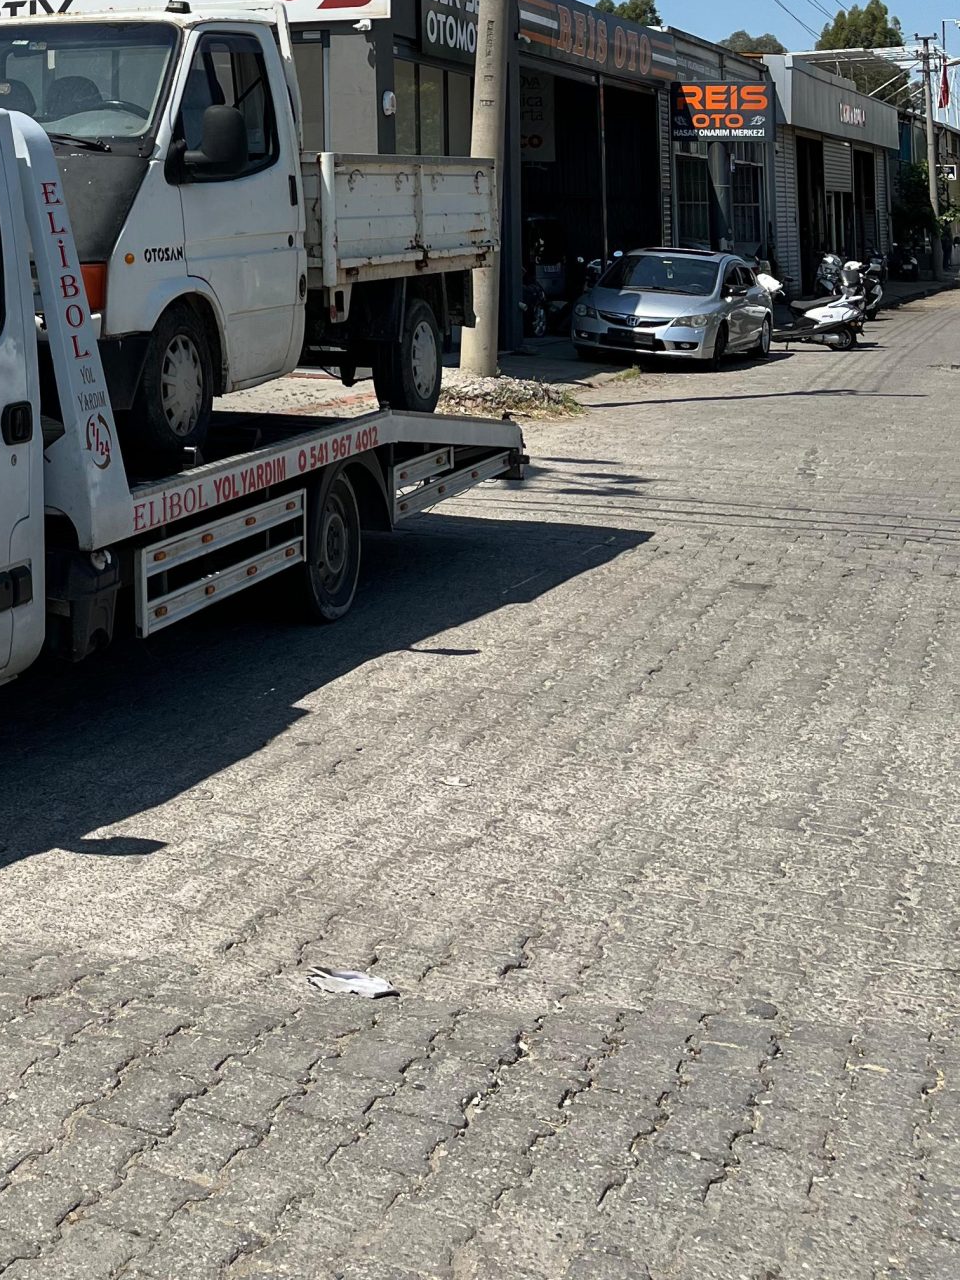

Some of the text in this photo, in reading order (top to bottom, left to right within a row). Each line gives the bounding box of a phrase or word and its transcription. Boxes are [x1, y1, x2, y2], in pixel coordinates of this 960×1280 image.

[614, 25, 652, 75] OTO
[692, 113, 744, 128] OTO
[698, 129, 730, 137] ONARIM
[731, 127, 765, 137] MERKEZİ
[143, 246, 184, 263] OTOSAN
[79, 364, 96, 385] YOL
[77, 390, 107, 412] YARDIM
[213, 475, 239, 504] YOL
[240, 456, 286, 492] YARDIM
[297, 450, 307, 472] 0
[309, 445, 329, 469] 541
[332, 434, 352, 460] 967
[355, 426, 379, 453] 4012
